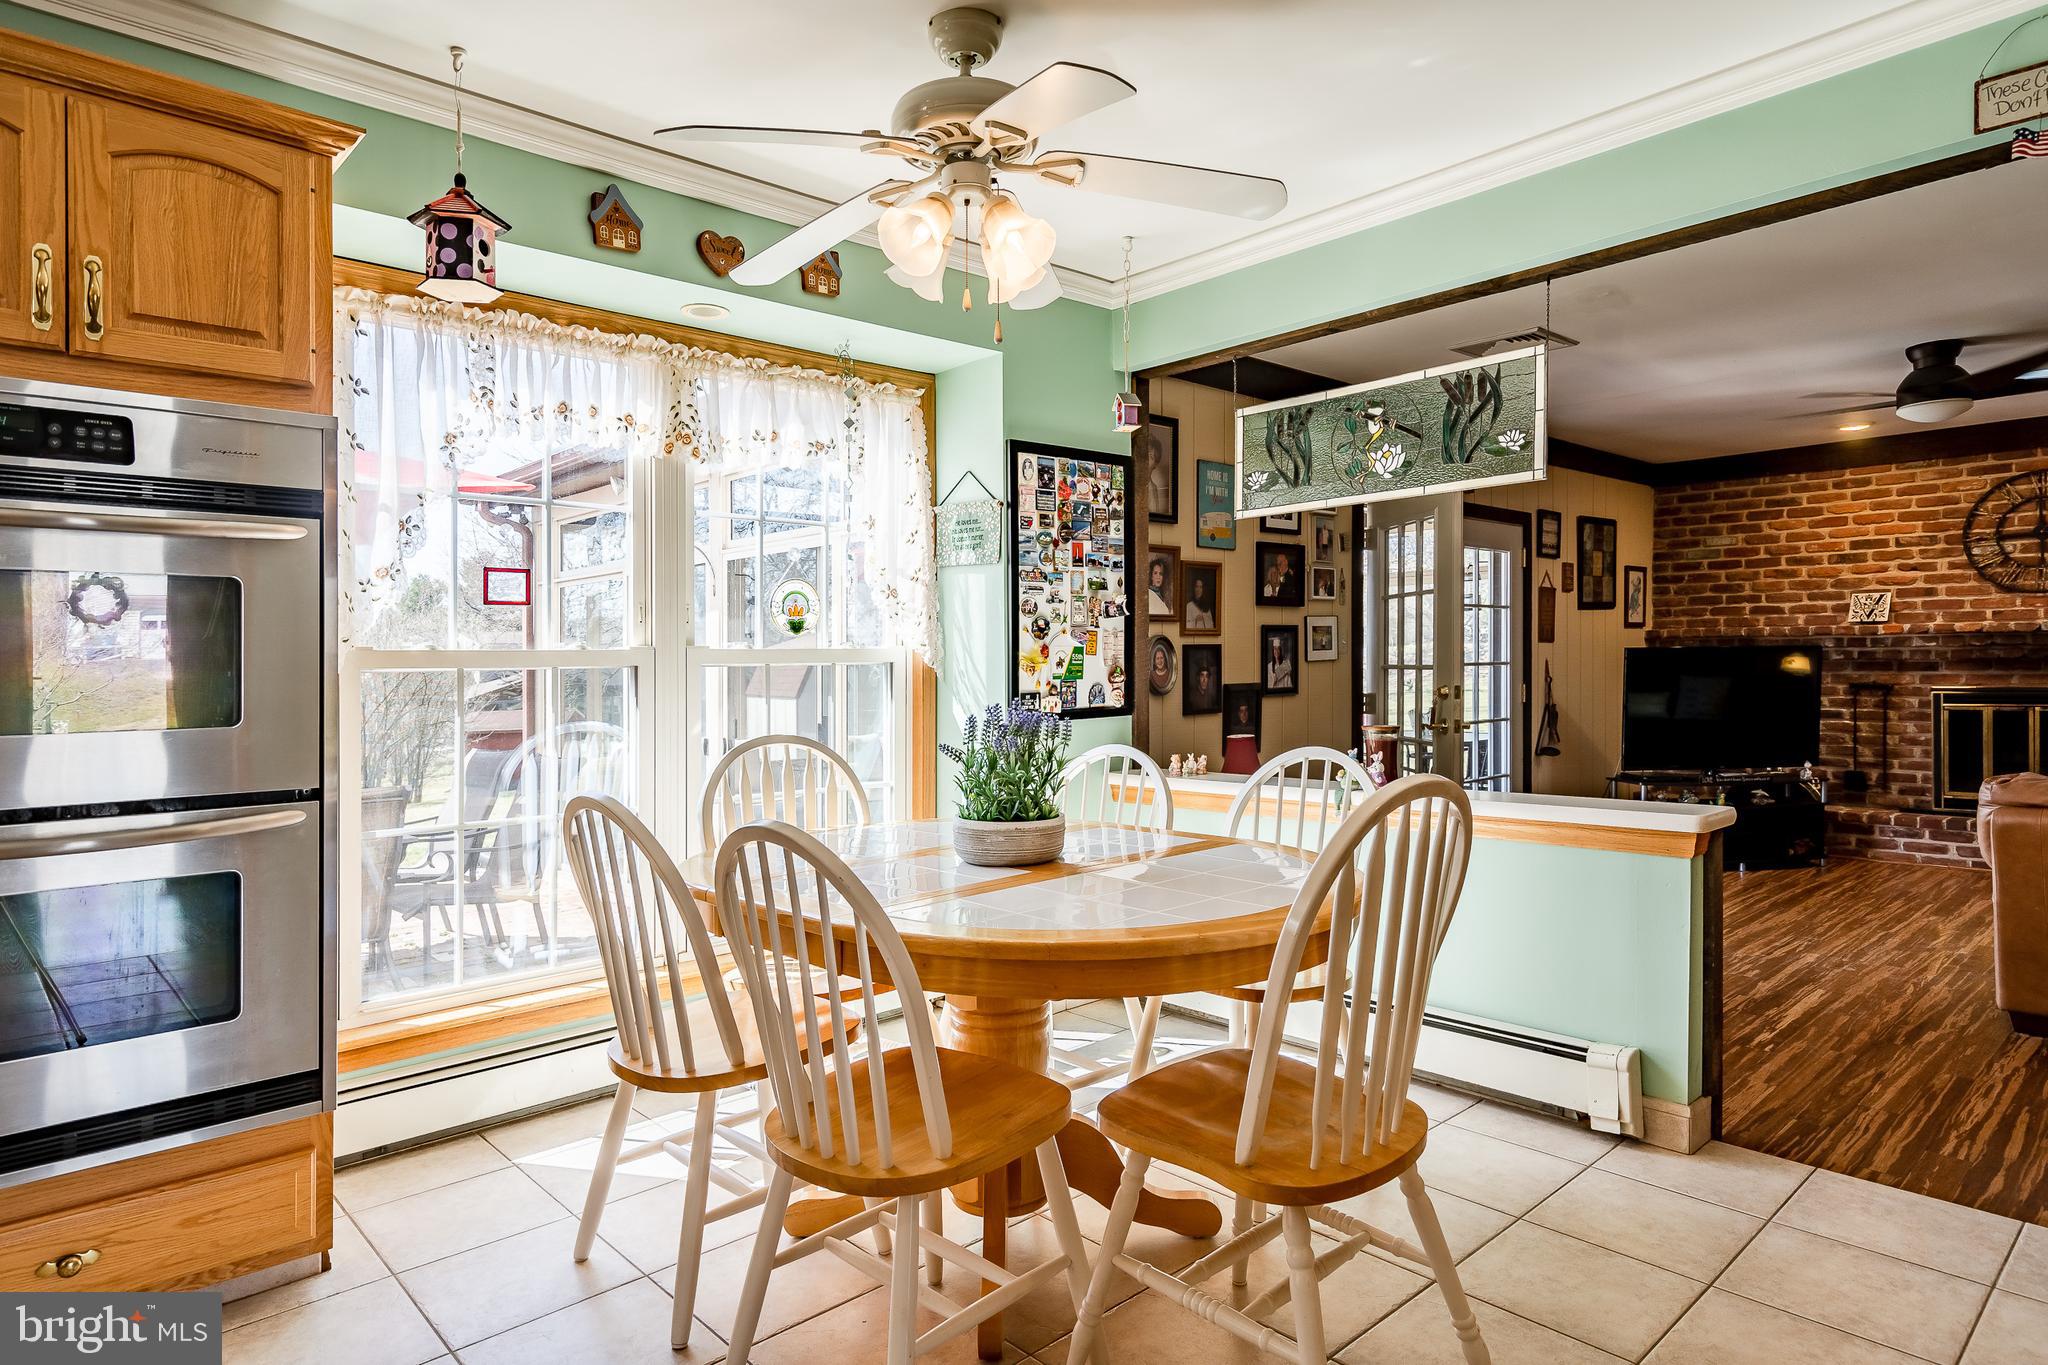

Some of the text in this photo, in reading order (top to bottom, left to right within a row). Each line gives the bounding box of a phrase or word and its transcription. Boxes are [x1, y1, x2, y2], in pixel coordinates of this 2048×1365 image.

[1982, 78, 2031, 102] These
[1993, 89, 2042, 116] Don't
[606, 214, 633, 228] Home
[707, 239, 737, 258] Sweet
